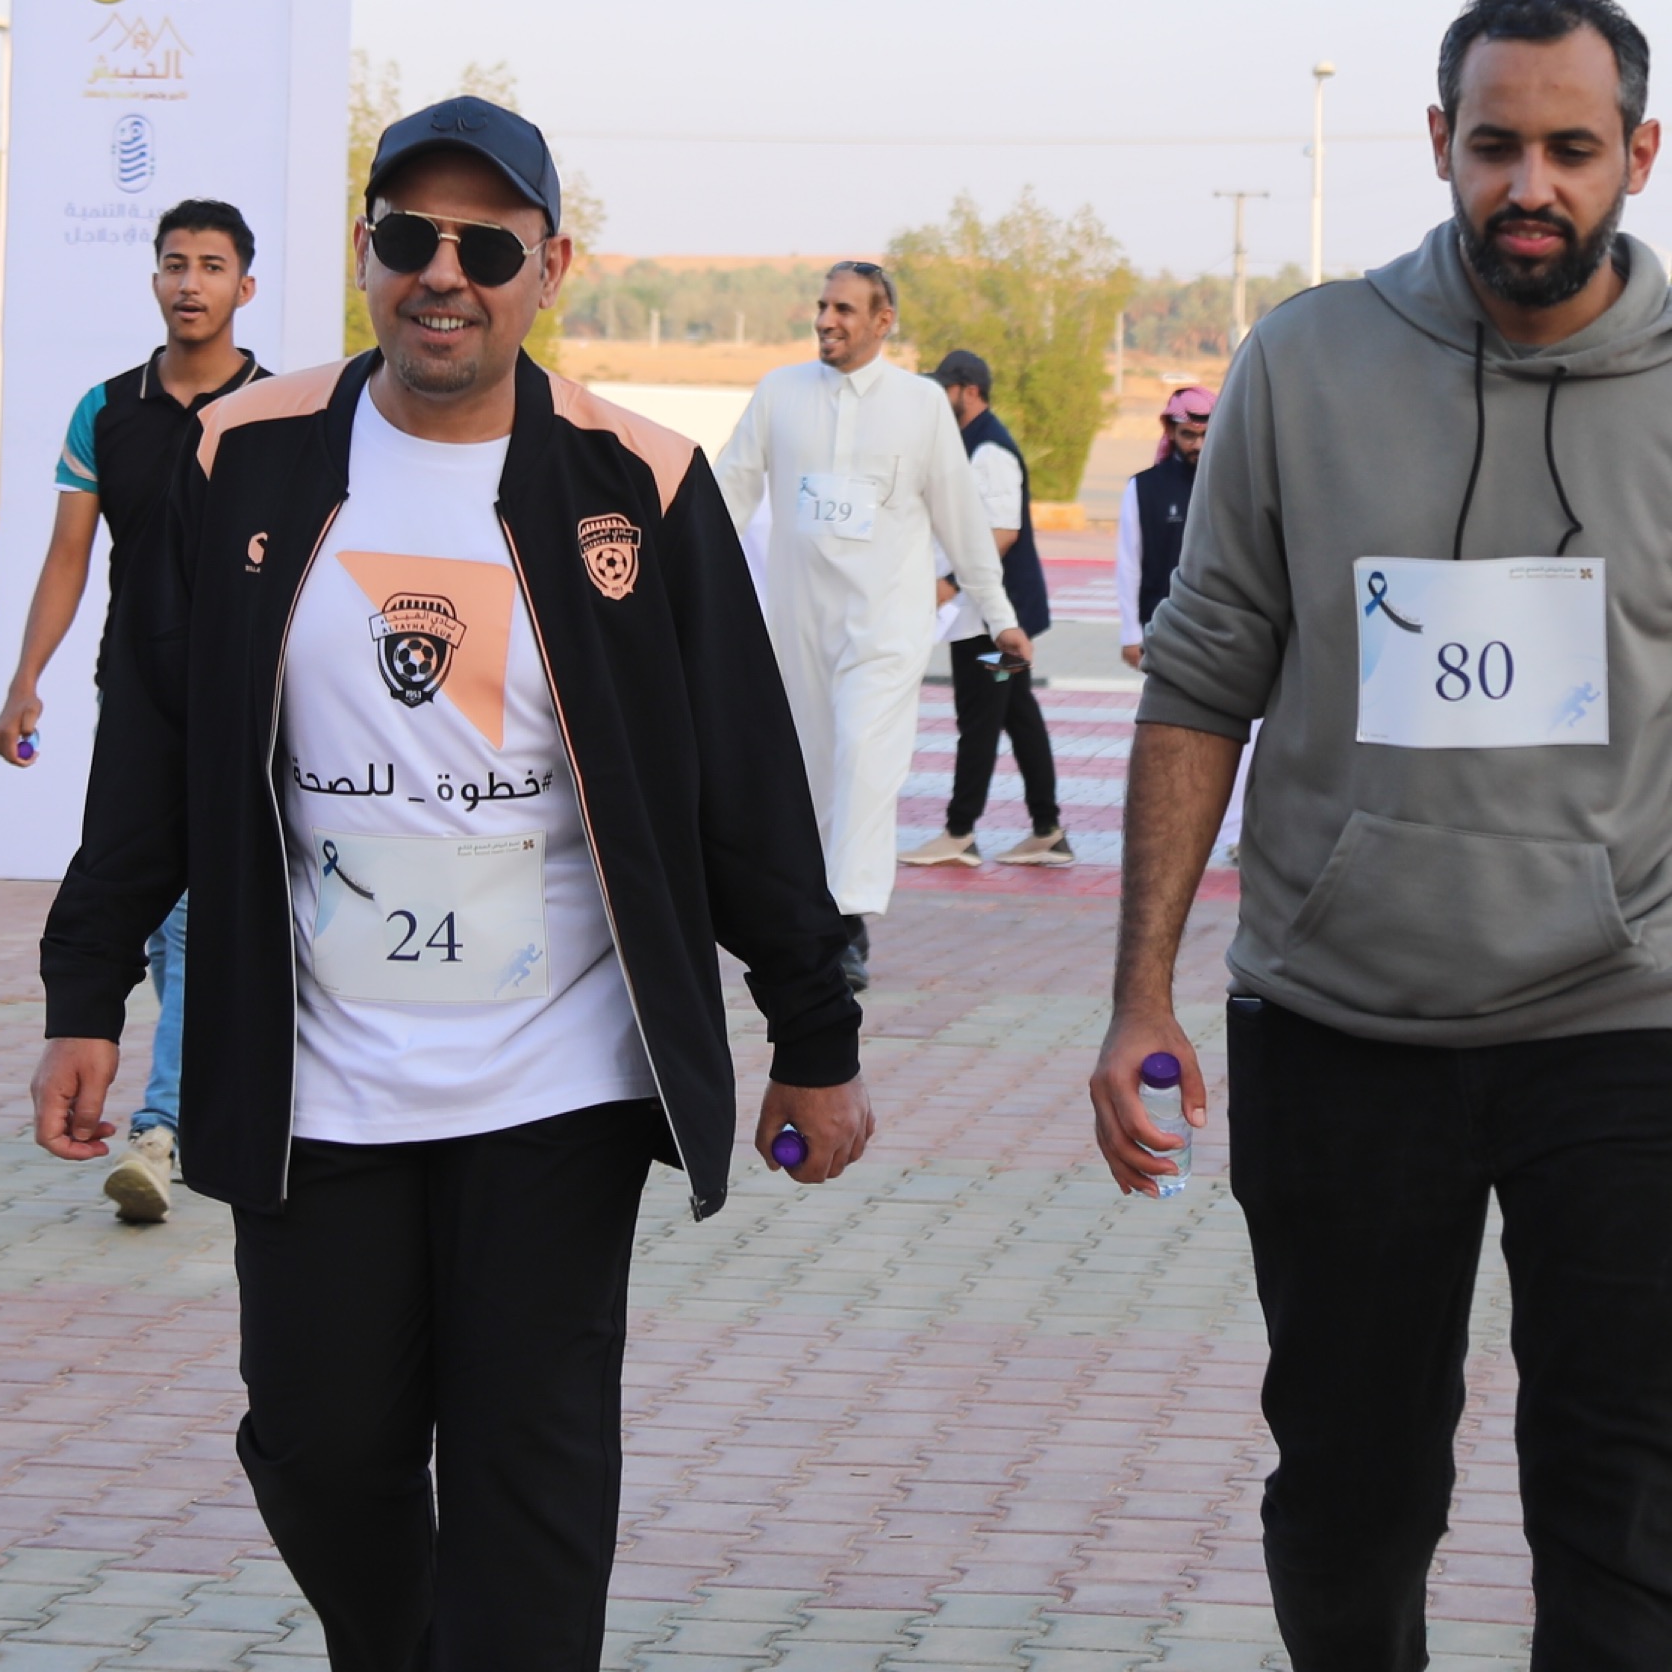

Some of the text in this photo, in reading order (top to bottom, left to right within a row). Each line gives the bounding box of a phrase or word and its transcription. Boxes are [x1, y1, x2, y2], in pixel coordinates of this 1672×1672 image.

[812, 499, 853, 522] 129
[1435, 641, 1515, 703] 80
[385, 910, 463, 963] 24
